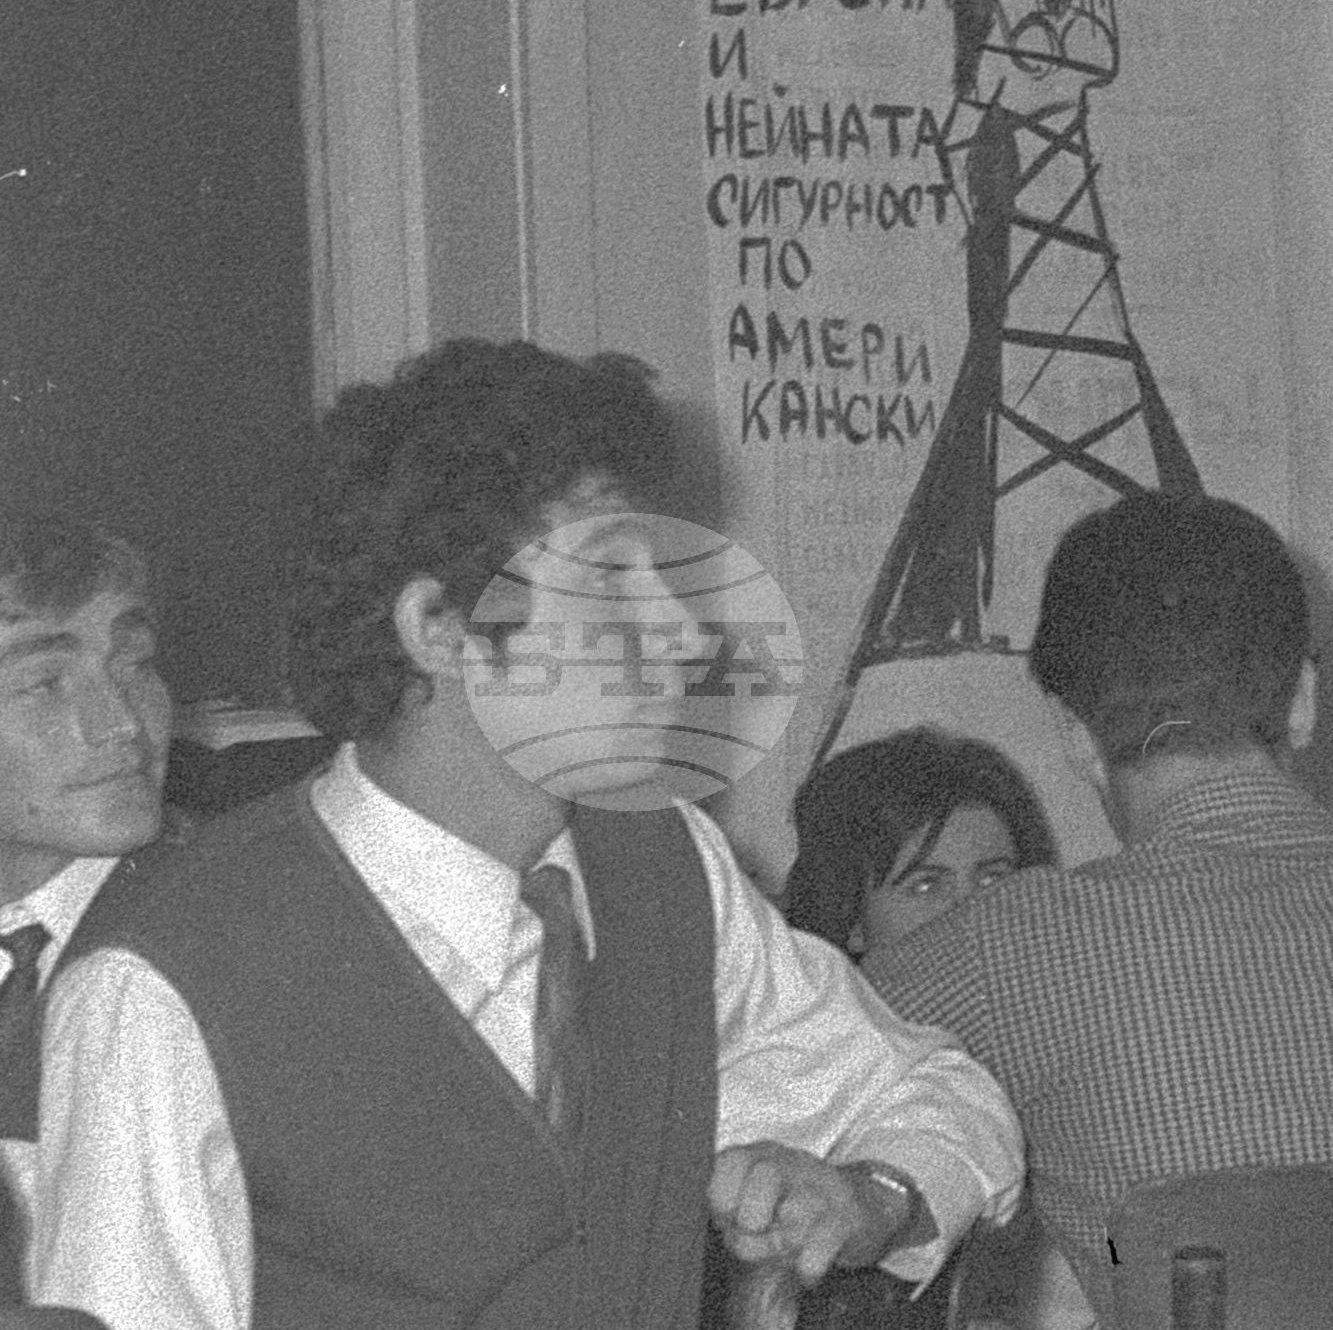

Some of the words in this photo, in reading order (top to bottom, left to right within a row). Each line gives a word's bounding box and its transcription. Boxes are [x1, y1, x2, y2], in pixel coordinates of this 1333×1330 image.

[708, 27, 748, 80] И
[704, 81, 942, 164] НЕЙНАТА
[705, 173, 954, 230] СИГУРНОСТ
[737, 236, 813, 290] ПО
[728, 301, 933, 384] АМЕРИ
[740, 378, 938, 446] КАНСКИ
